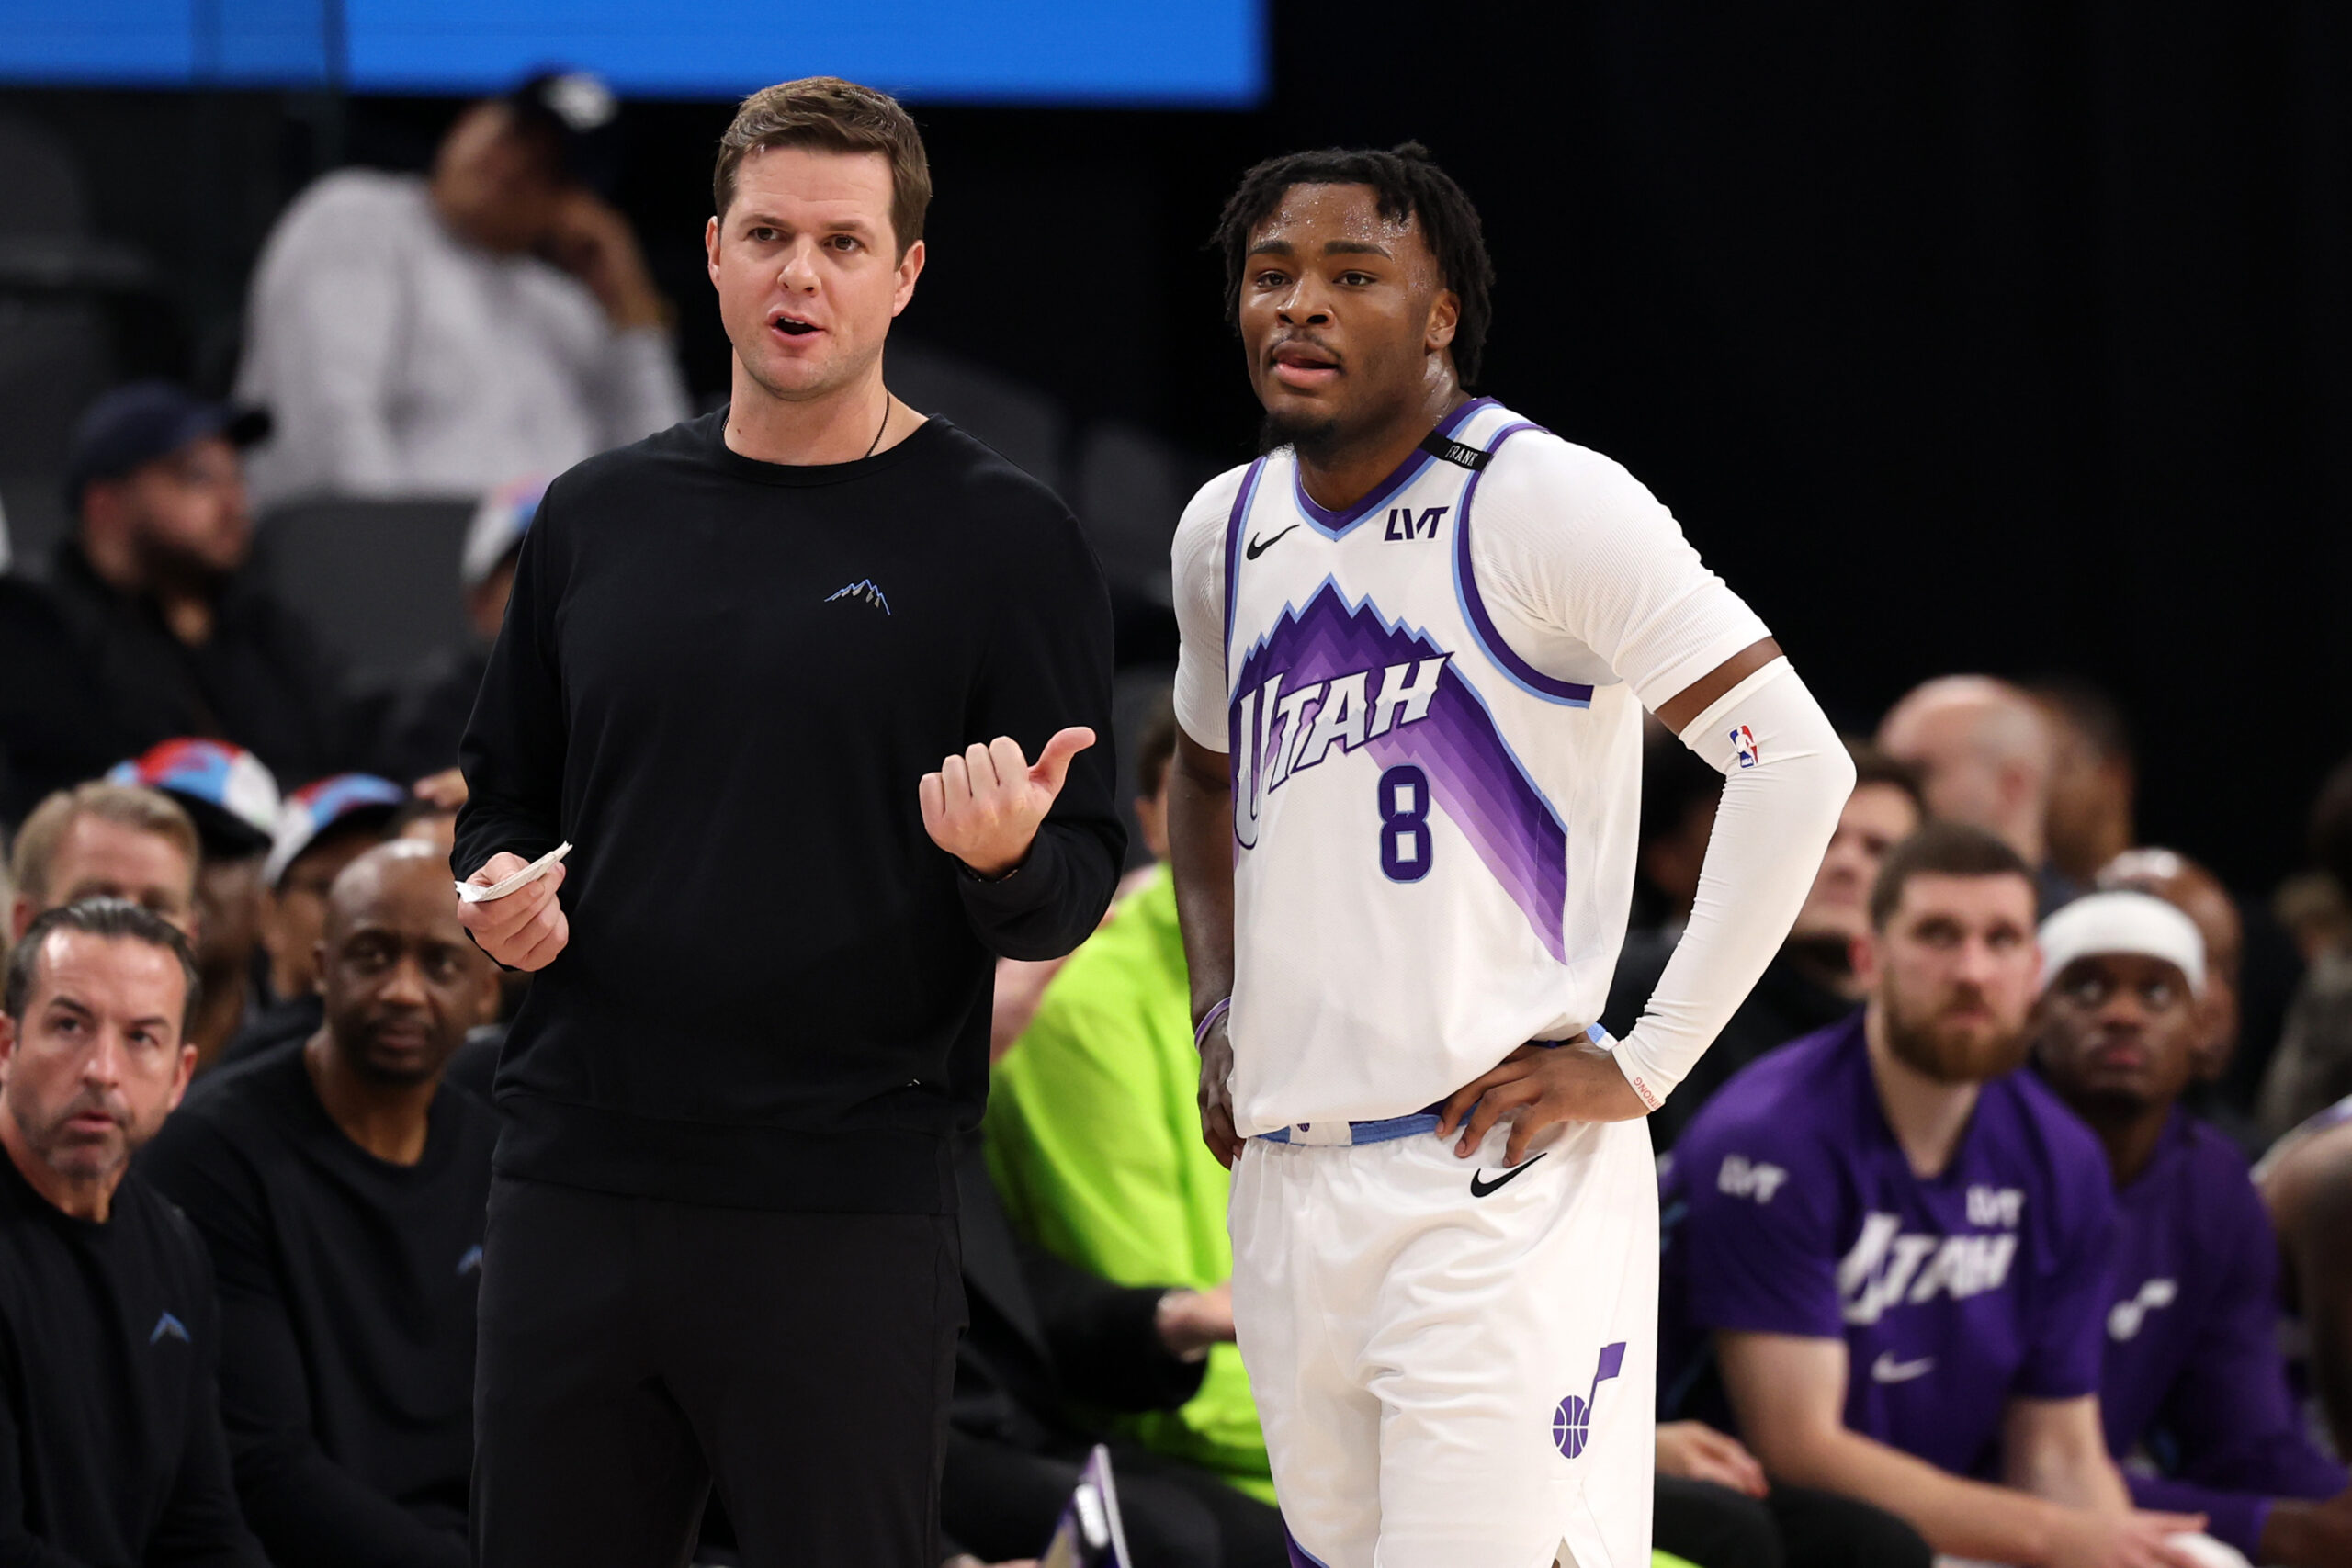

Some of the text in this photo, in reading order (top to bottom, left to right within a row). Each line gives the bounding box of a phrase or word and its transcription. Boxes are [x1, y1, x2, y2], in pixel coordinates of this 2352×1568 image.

[1445, 445, 1479, 467] FRANK
[1384, 506, 1451, 542] LVT
[1235, 651, 1455, 851] UTAH
[1378, 762, 1433, 884] 8
[1838, 1211, 2018, 1325] UTAH
